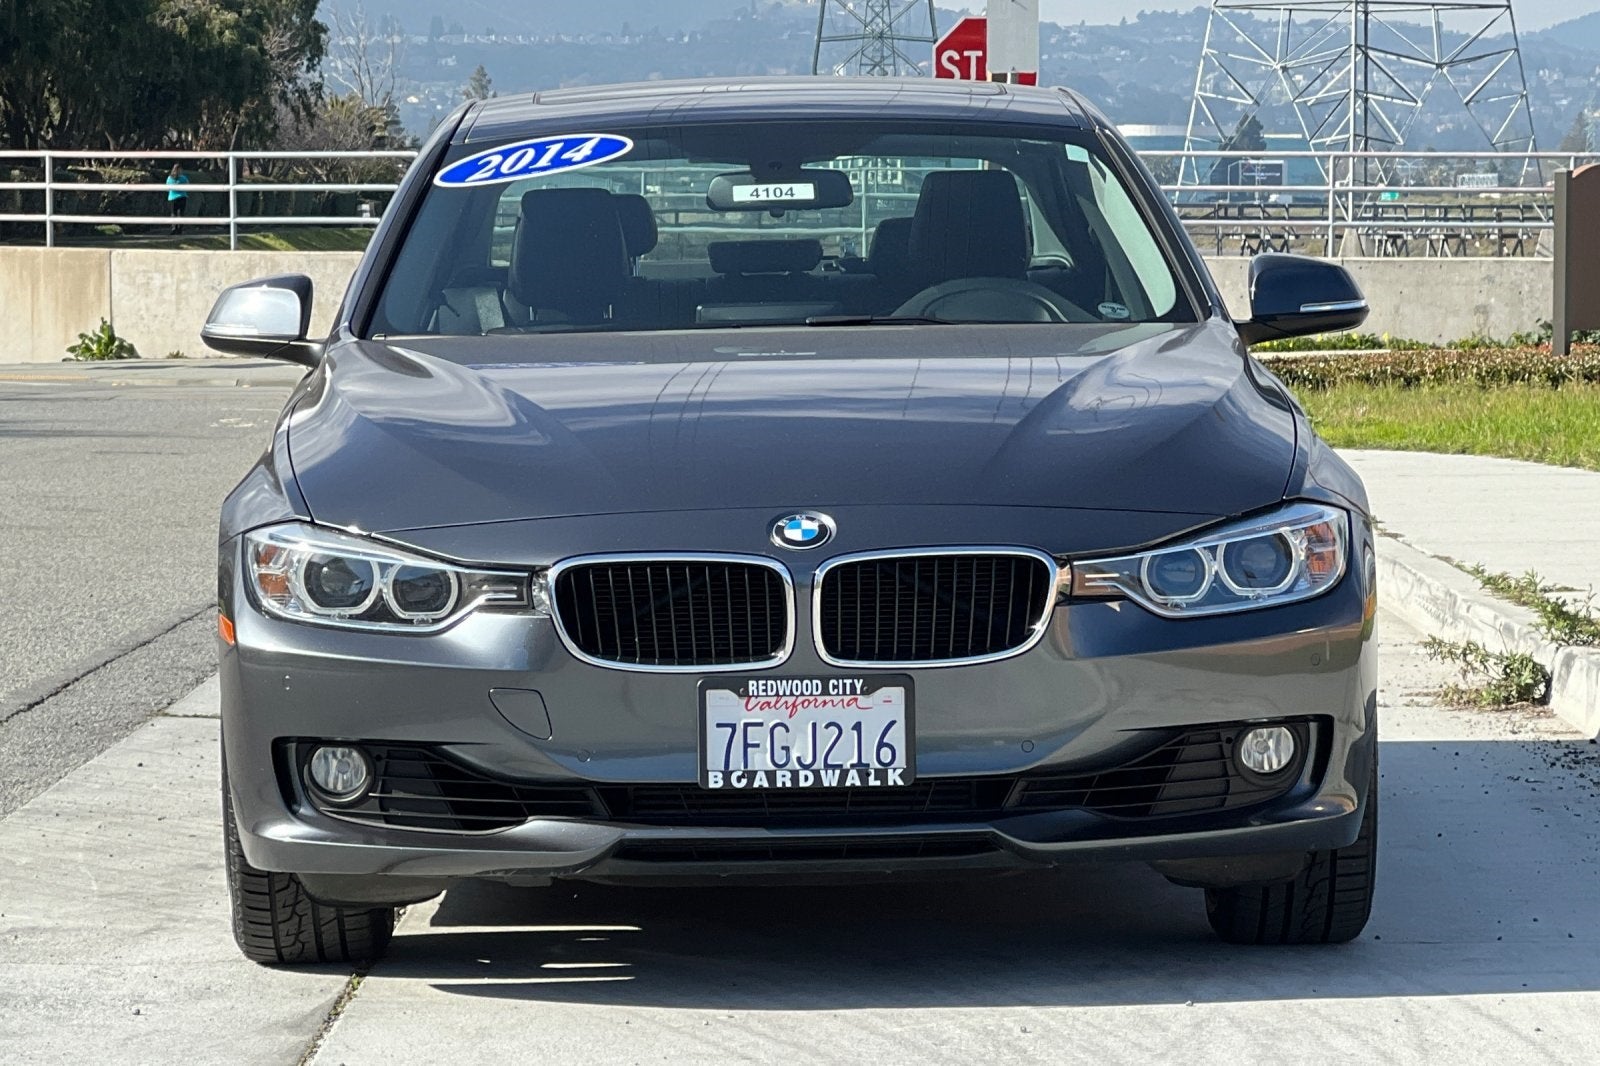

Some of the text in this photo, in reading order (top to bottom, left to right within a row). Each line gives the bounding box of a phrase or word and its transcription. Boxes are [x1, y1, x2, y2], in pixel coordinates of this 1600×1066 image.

[941, 49, 983, 80] ST
[464, 136, 600, 182] 2014
[750, 187, 795, 198] 4104
[748, 679, 863, 696] REDWOOD CITY
[744, 695, 873, 719] California
[715, 720, 898, 771] 7FGJ216
[708, 769, 904, 788] BOARDWALK
